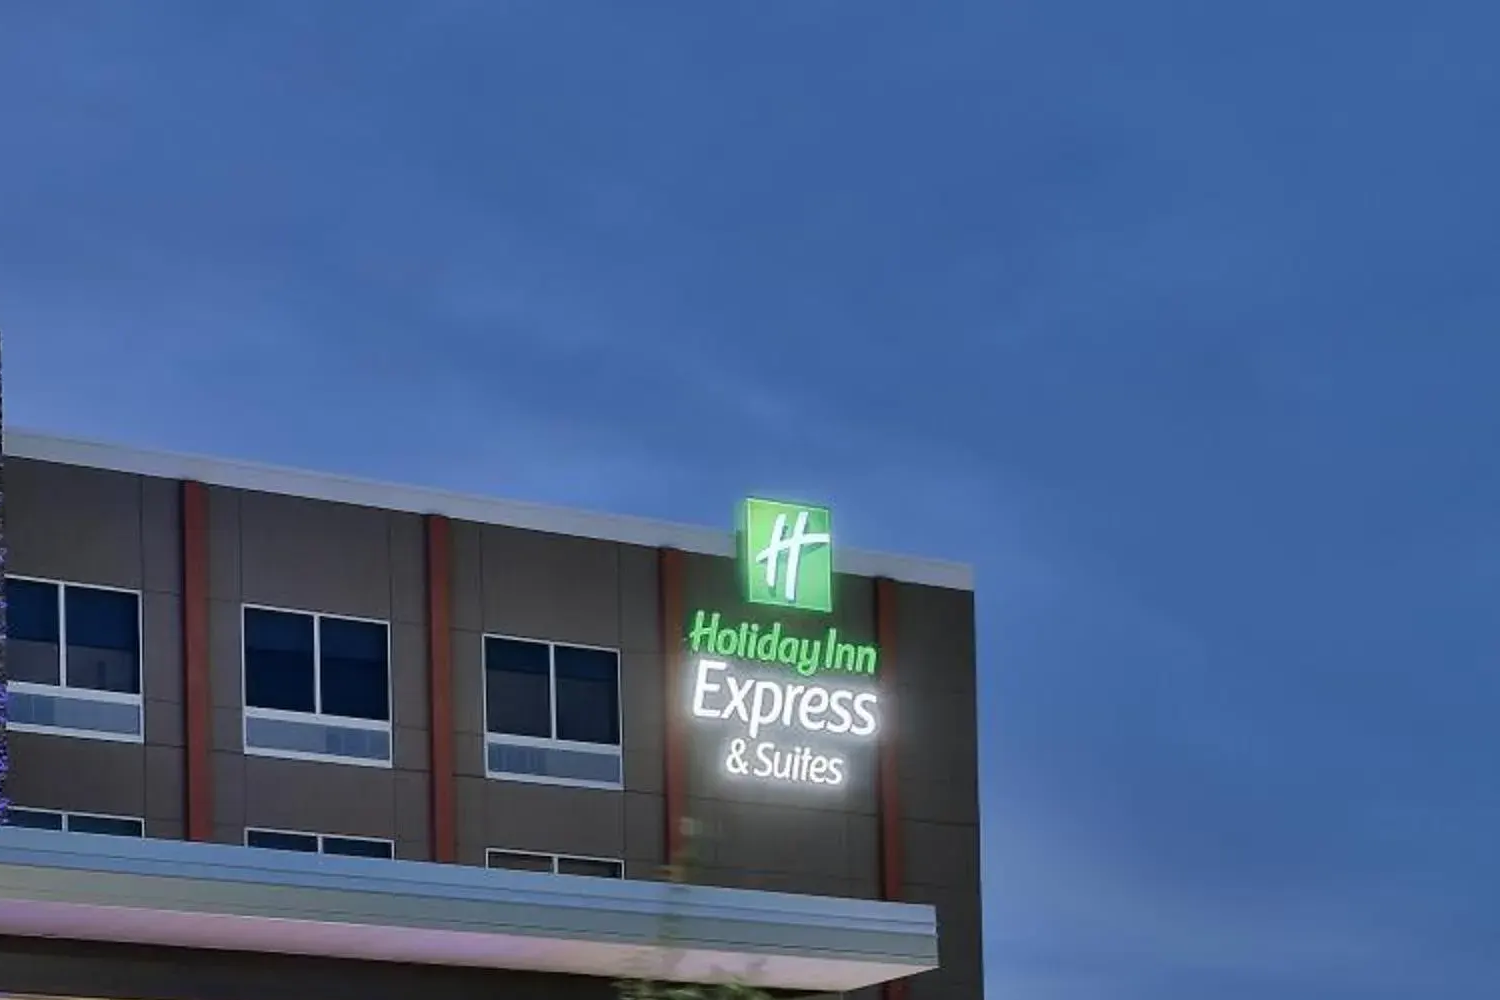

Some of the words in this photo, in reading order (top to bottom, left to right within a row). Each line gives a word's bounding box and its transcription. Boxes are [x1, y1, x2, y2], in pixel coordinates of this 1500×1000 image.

[689, 610, 820, 676] Holiday
[825, 627, 877, 675] Inn
[692, 659, 878, 739] Express
[726, 738, 748, 774] &
[753, 742, 843, 785] Suites
